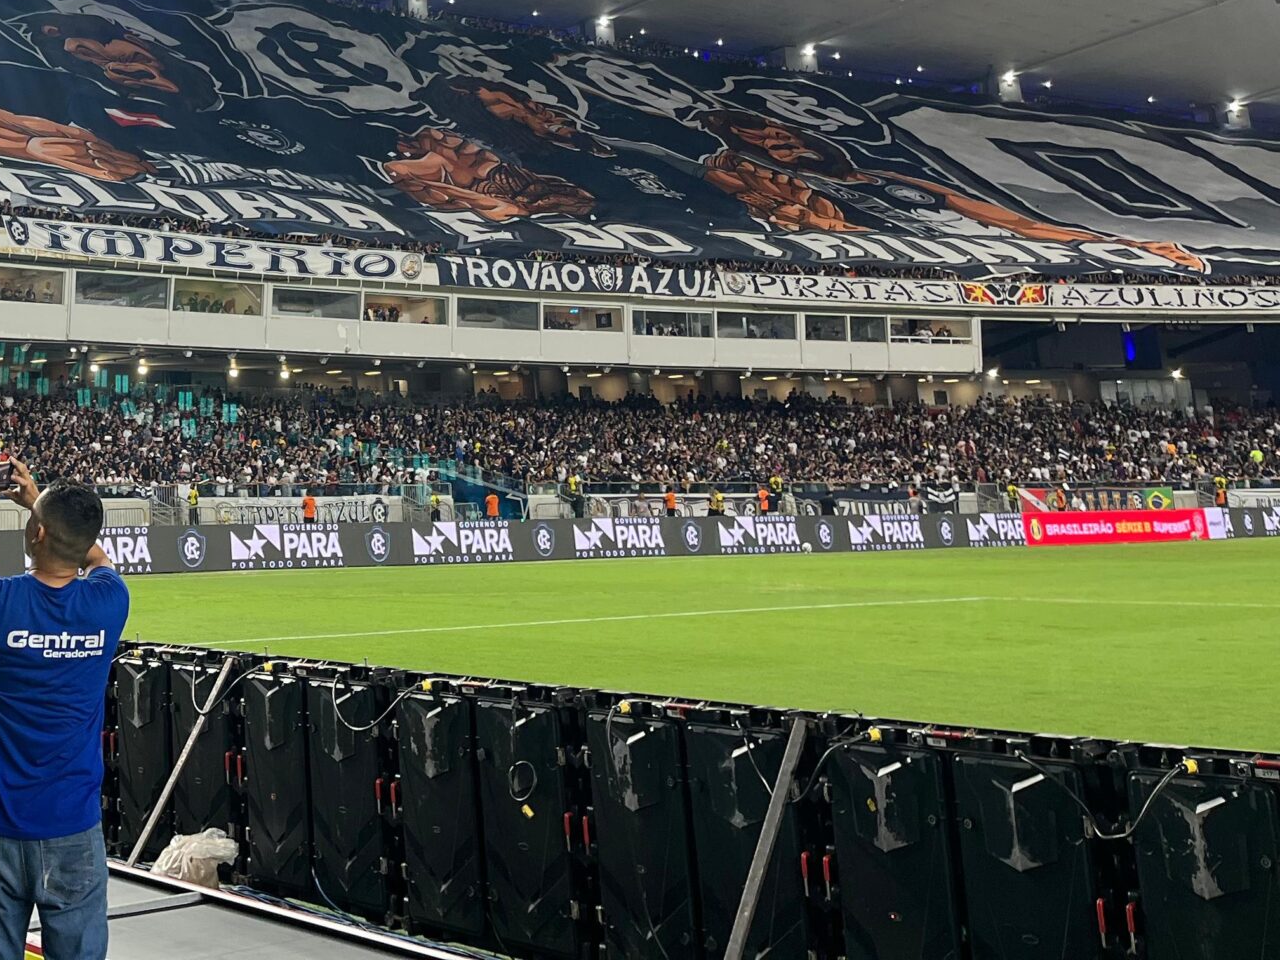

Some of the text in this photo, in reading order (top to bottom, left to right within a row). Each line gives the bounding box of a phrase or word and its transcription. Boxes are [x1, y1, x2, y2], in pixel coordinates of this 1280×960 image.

[424, 210, 518, 241] E
[535, 217, 695, 254] DO
[711, 230, 1182, 269] TRIUNFO
[440, 256, 585, 291] TROVÃO
[629, 266, 717, 297] AZUL
[745, 274, 954, 303] PIRATAS
[1062, 286, 1280, 308] AZULINOS
[98, 527, 148, 535] VERNO DO
[614, 517, 647, 525] GOVERNO
[883, 520, 924, 543] PARÁ
[997, 519, 1026, 540] PAR
[1045, 519, 1191, 536] BRASILEIRÃO SÉRIE B SUPERBET
[458, 528, 514, 554] PARÁ
[614, 524, 666, 548] PARÁ
[755, 521, 800, 545] PARÁ
[97, 535, 152, 564] ARÁ
[282, 532, 344, 559] PARÁ
[576, 550, 596, 558] POR
[600, 549, 626, 557] TODO
[642, 547, 666, 556] PARÁ
[851, 543, 867, 551] POR
[121, 563, 152, 574] PARÁ
[231, 561, 254, 569] POR
[261, 560, 293, 568] TODO
[314, 558, 344, 567] PARÁ
[413, 556, 435, 564] POR
[440, 555, 469, 563] TODO
[488, 552, 514, 561] PARÁ
[43, 649, 103, 659] Geradores
